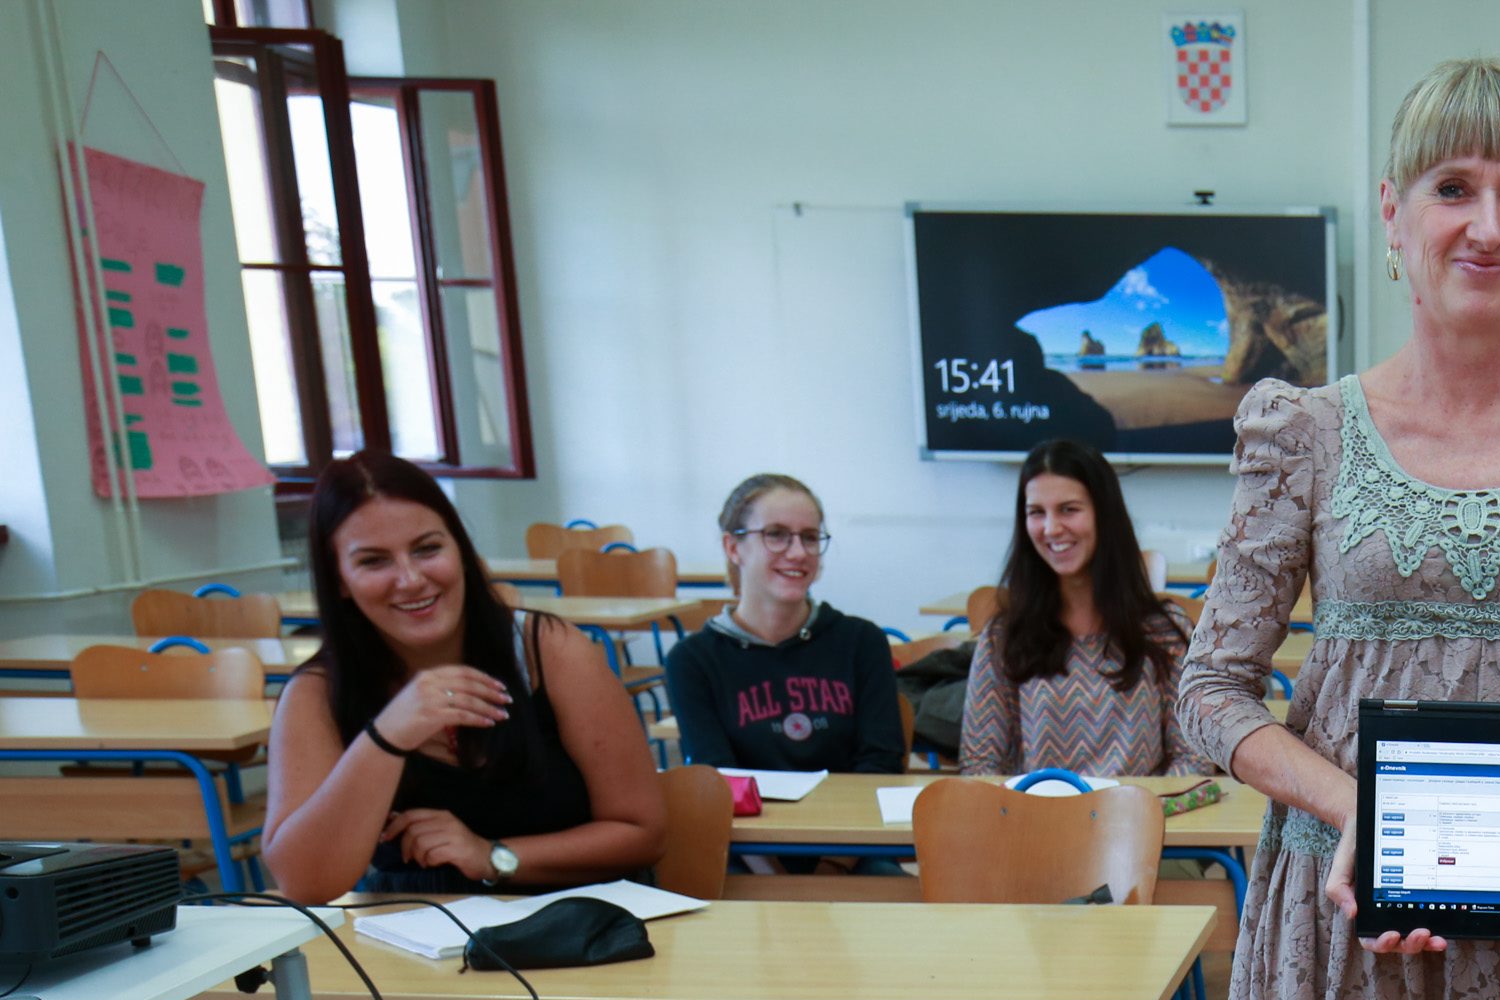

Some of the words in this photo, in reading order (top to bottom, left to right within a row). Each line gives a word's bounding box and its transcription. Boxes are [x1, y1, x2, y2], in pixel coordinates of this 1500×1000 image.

[934, 358, 1015, 394] 15:41
[936, 401, 989, 422] srijeda,
[992, 401, 1008, 419] 6.
[1010, 402, 1050, 423] rujna
[737, 681, 782, 727] ALL
[786, 676, 853, 715] STAR
